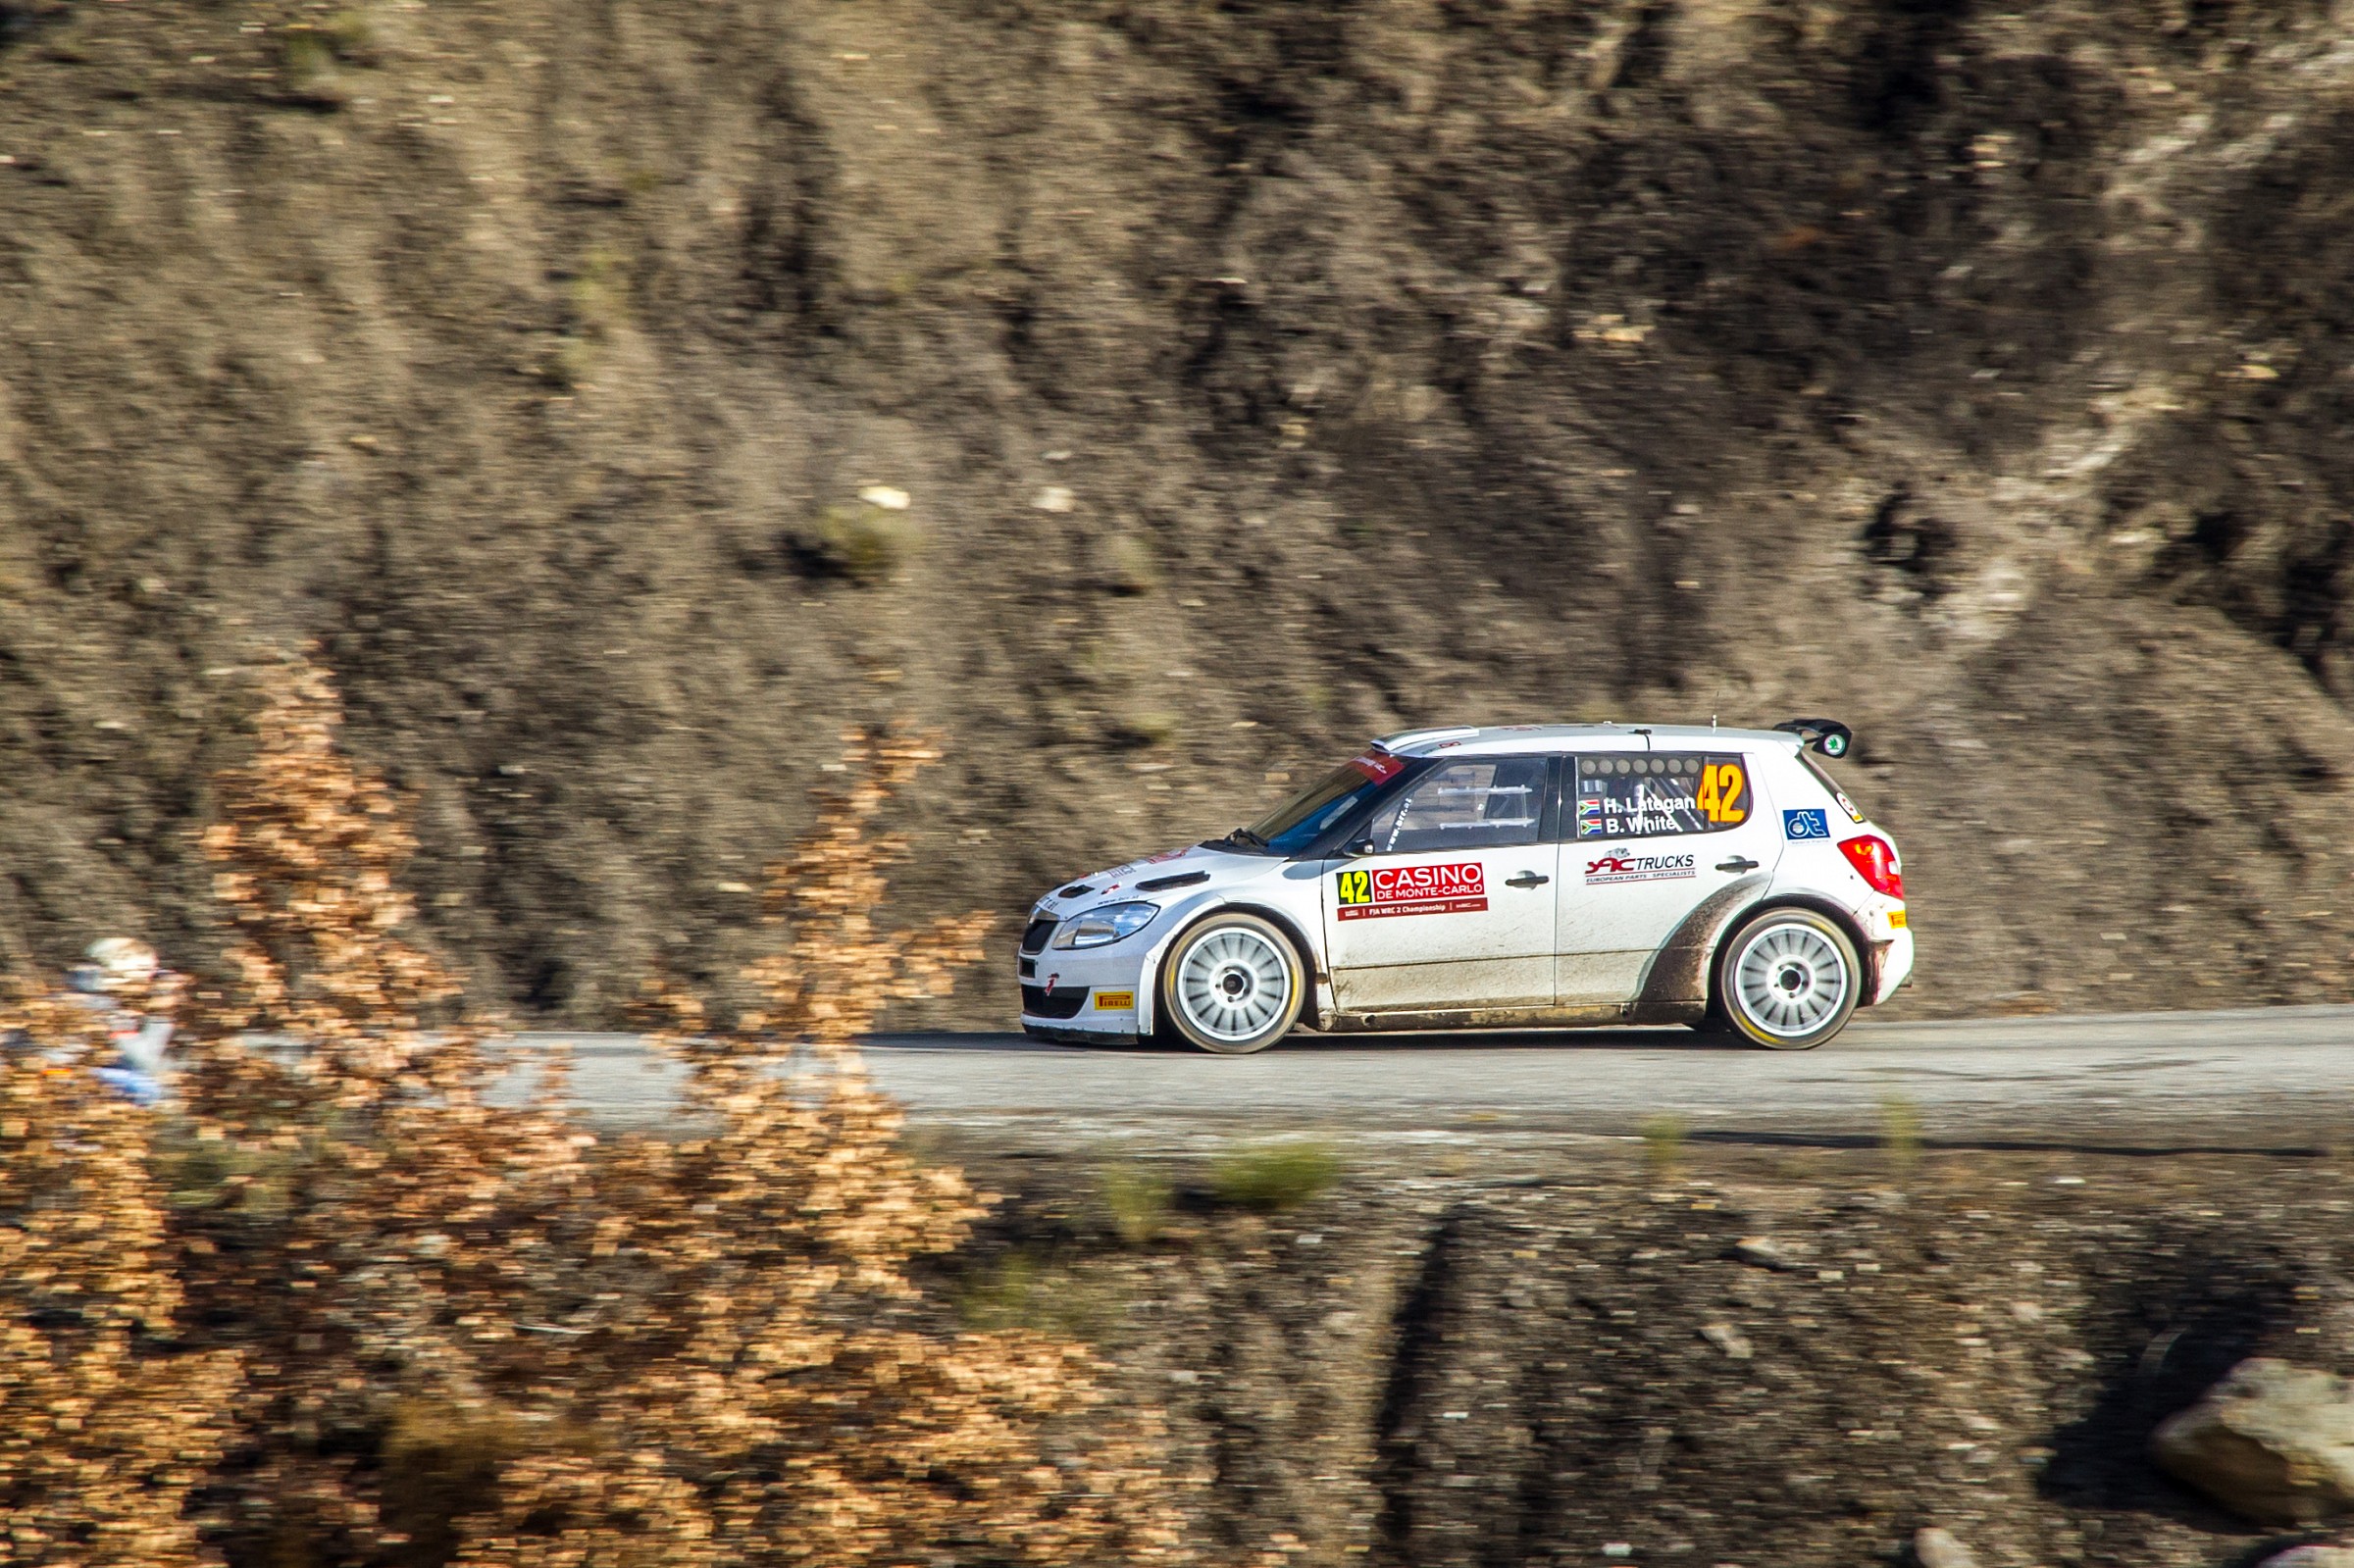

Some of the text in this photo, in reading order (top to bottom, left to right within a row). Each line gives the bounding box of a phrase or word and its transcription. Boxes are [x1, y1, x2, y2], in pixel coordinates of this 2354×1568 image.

[1696, 763, 1745, 823] 42
[1604, 797, 1621, 814] H.
[1607, 815, 1676, 834] B. White
[1636, 854, 1694, 871] TRUCKS
[1375, 864, 1482, 889] CASINO
[1339, 871, 1371, 904] 42
[1376, 884, 1483, 900] DE MONTE-CARLO
[1099, 994, 1131, 1007] PIRELLI
